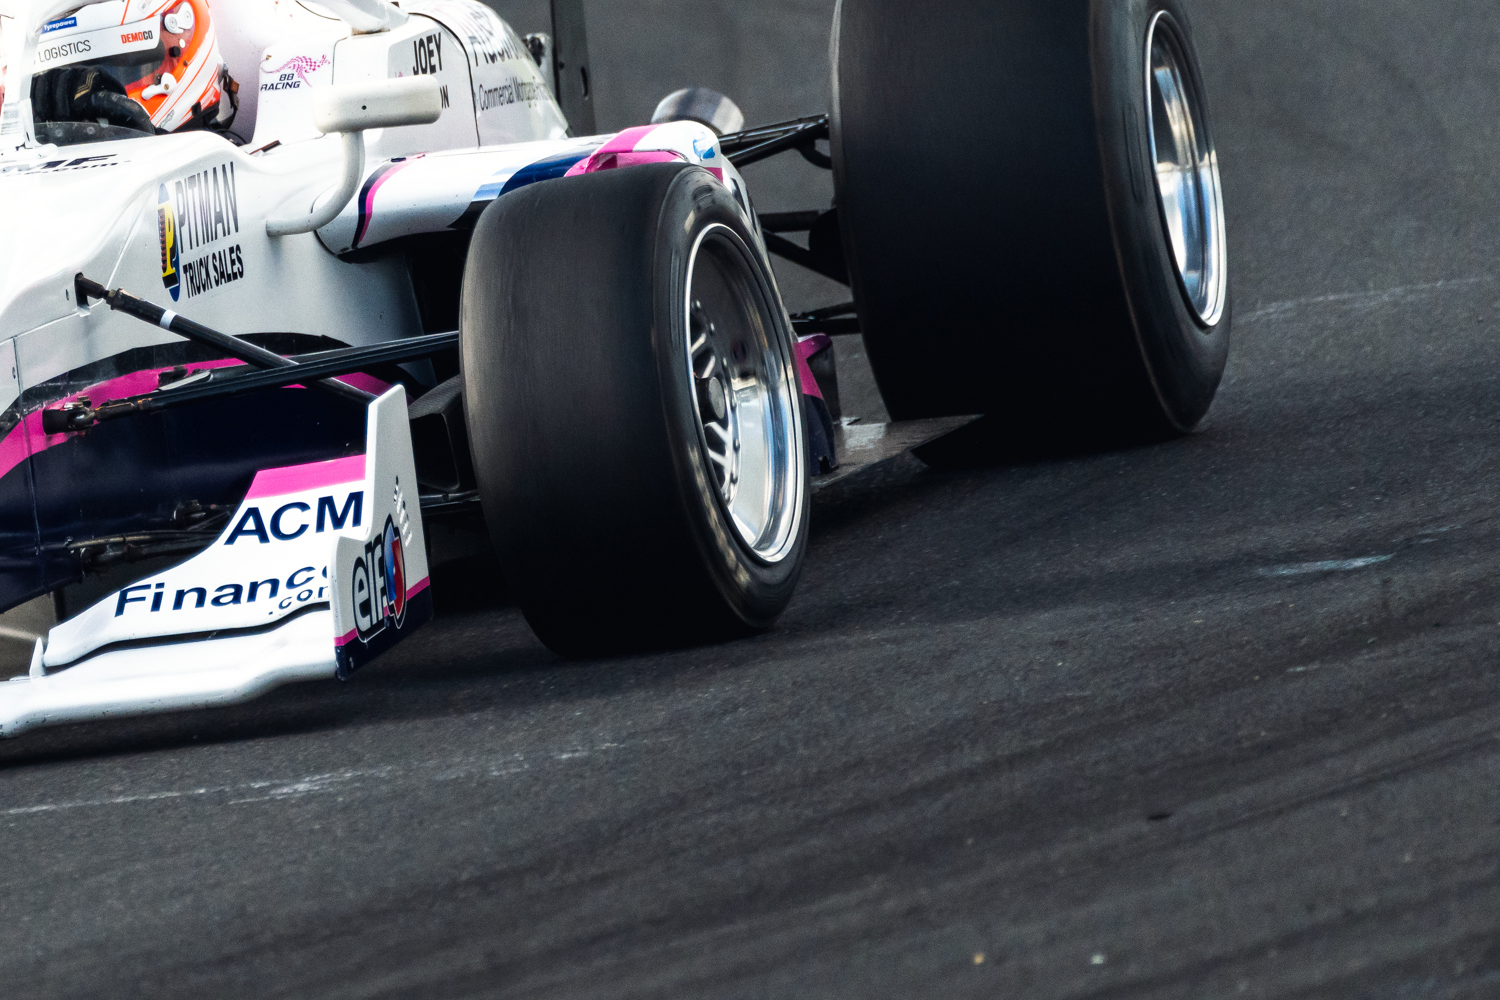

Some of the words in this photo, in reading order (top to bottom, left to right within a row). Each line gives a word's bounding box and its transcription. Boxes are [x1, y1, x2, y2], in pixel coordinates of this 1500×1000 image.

[43, 18, 75, 31] Tyrepower
[121, 30, 153, 44] DEMOCO
[38, 40, 91, 62] LOGISTICS
[413, 32, 442, 75] JOEY
[260, 81, 301, 91] RACING
[175, 161, 239, 254] PITMAN
[182, 255, 213, 298] TRUCK
[212, 244, 244, 287] SALES
[224, 491, 364, 545] ACM
